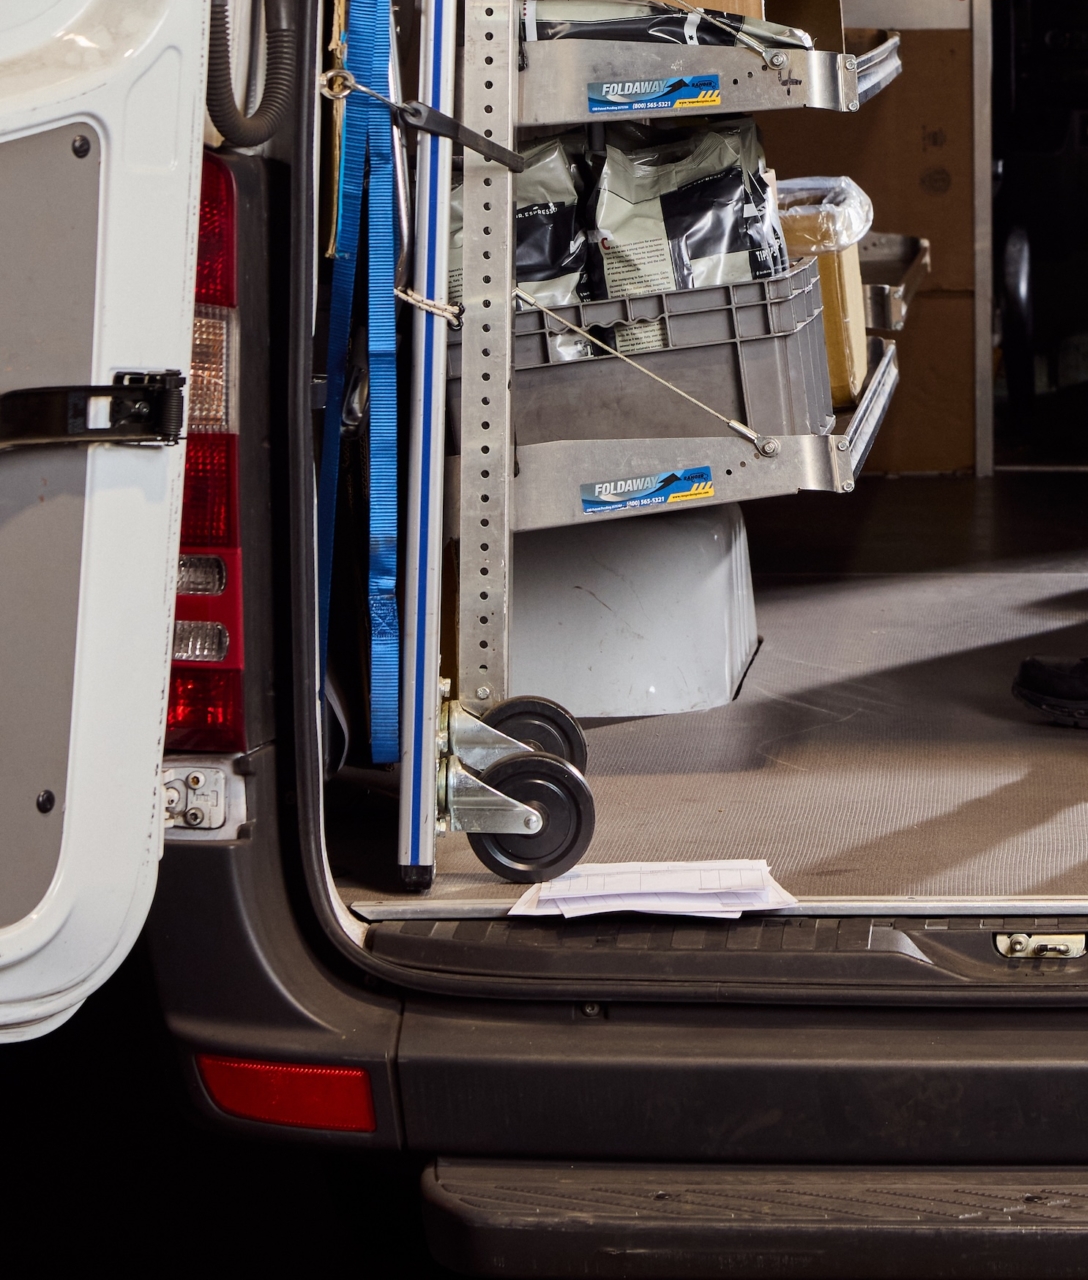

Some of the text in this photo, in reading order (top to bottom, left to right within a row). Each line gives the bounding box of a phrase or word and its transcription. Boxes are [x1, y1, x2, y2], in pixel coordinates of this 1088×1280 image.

[602, 81, 668, 96] FOLDAWAY
[632, 102, 646, 110] (800)
[647, 101, 671, 109] 565-5321
[595, 476, 660, 496] FOLDAWAY
[641, 497, 665, 506] 565-5321
